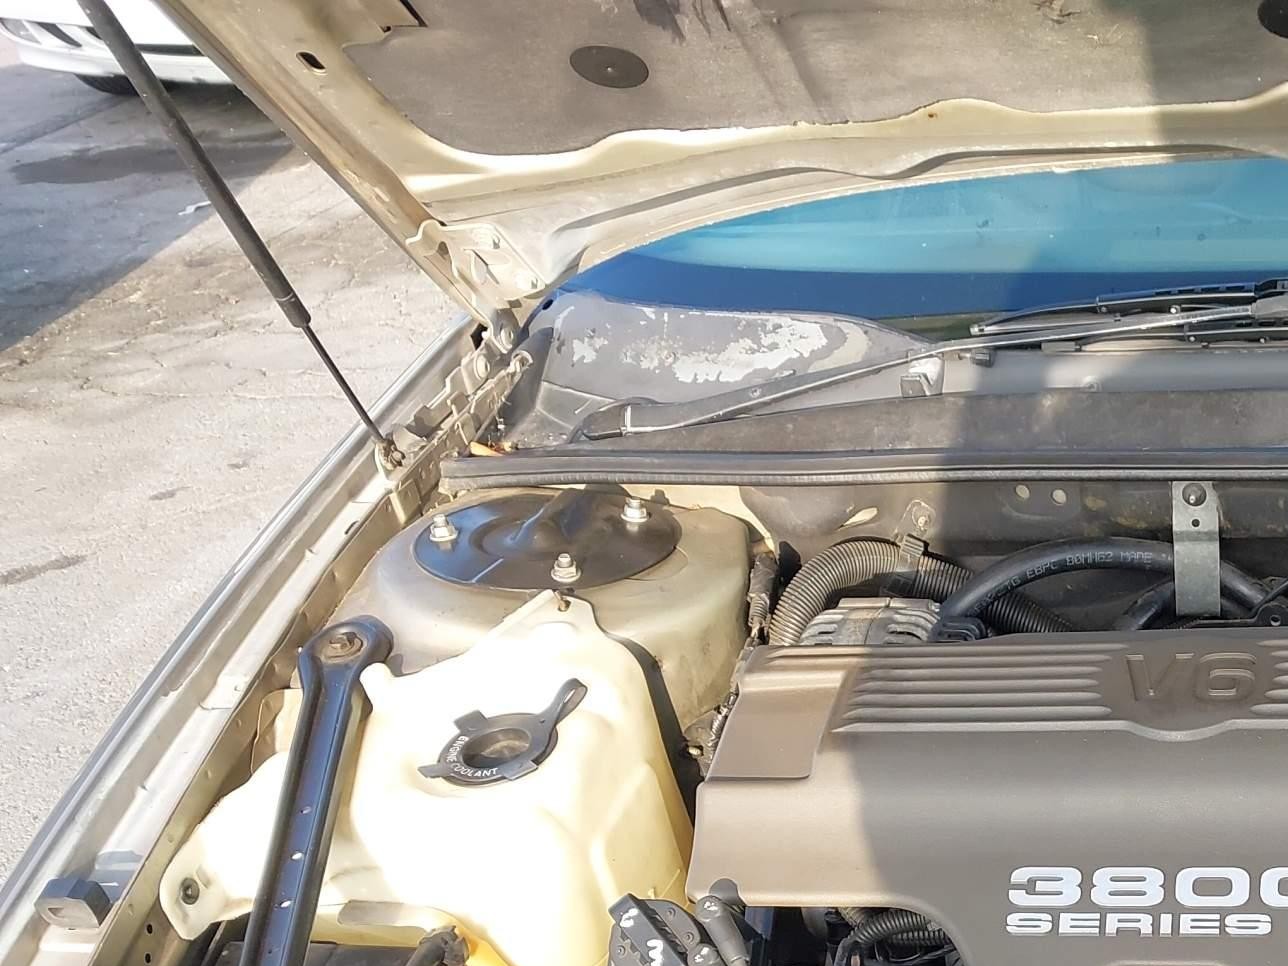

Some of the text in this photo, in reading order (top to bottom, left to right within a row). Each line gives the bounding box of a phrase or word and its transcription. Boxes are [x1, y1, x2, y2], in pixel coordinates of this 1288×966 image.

[1119, 551, 1153, 563] MADE
[1124, 652, 1257, 702] V6
[446, 735, 499, 779] ENGINE COOLANT
[1005, 912, 1272, 937] SERIES
